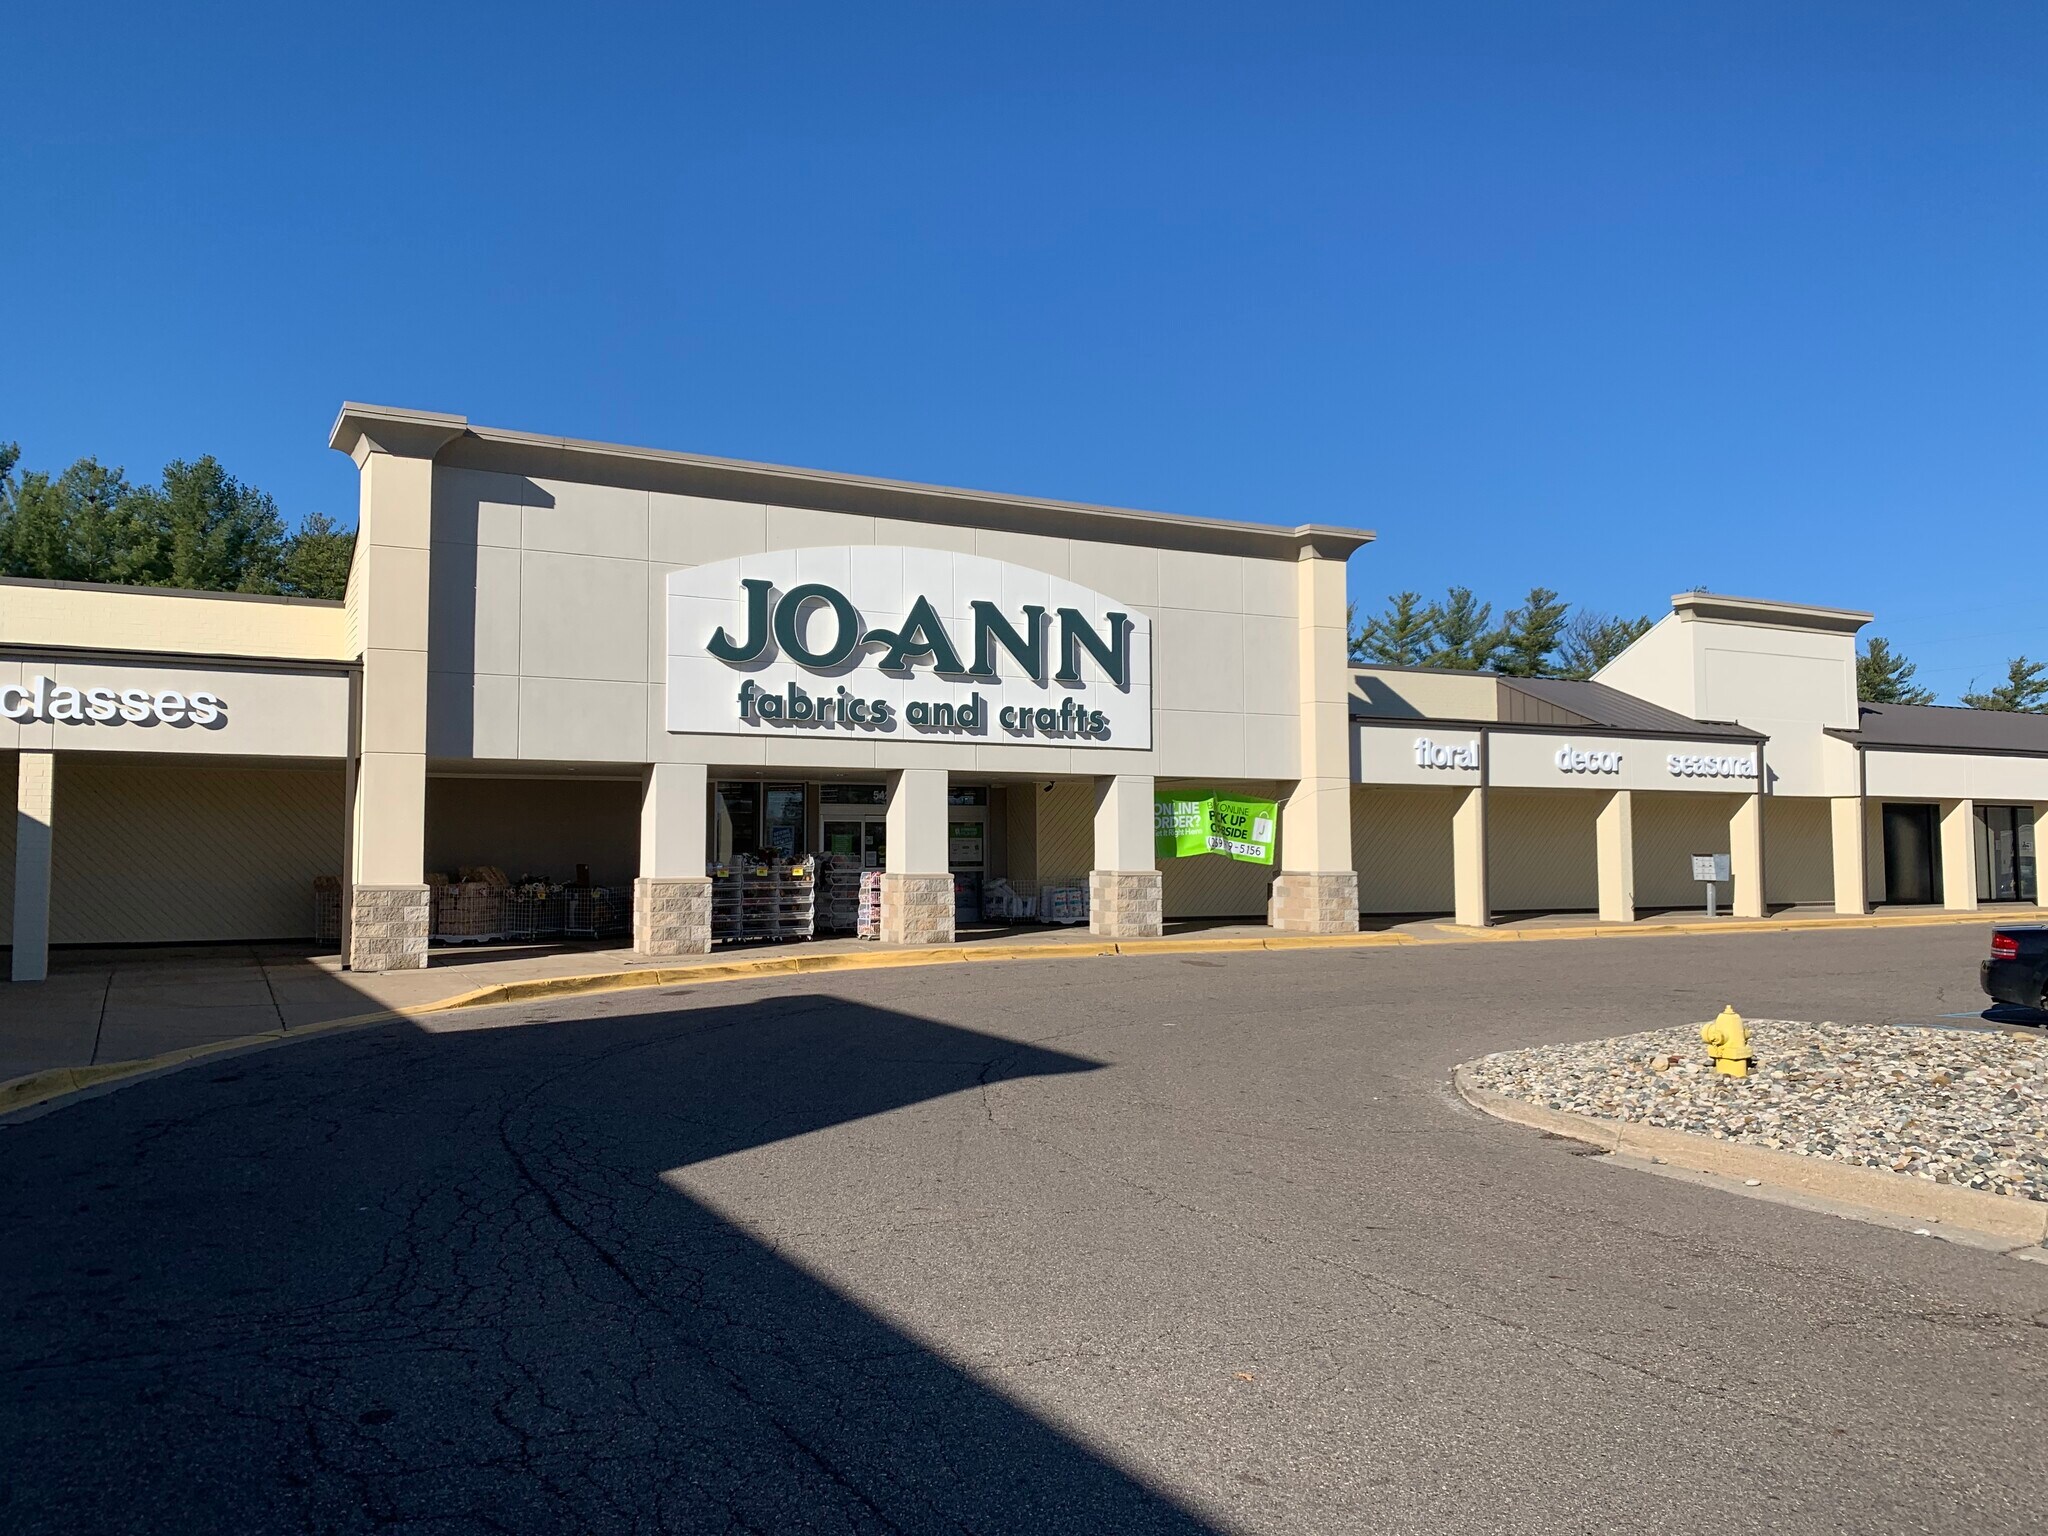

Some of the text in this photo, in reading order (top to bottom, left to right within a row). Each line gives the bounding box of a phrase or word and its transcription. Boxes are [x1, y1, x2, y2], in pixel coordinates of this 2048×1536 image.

[0, 675, 219, 724] classes
[738, 679, 1106, 734] fabrics and crafts
[1414, 736, 1480, 768] floral
[1554, 744, 1622, 773] decor
[1667, 752, 1759, 778] seasonal
[1154, 801, 1200, 815] ONLINE
[1219, 803, 1249, 816] ONLINE
[1230, 814, 1246, 826] UP
[1154, 814, 1201, 829] ORDER?
